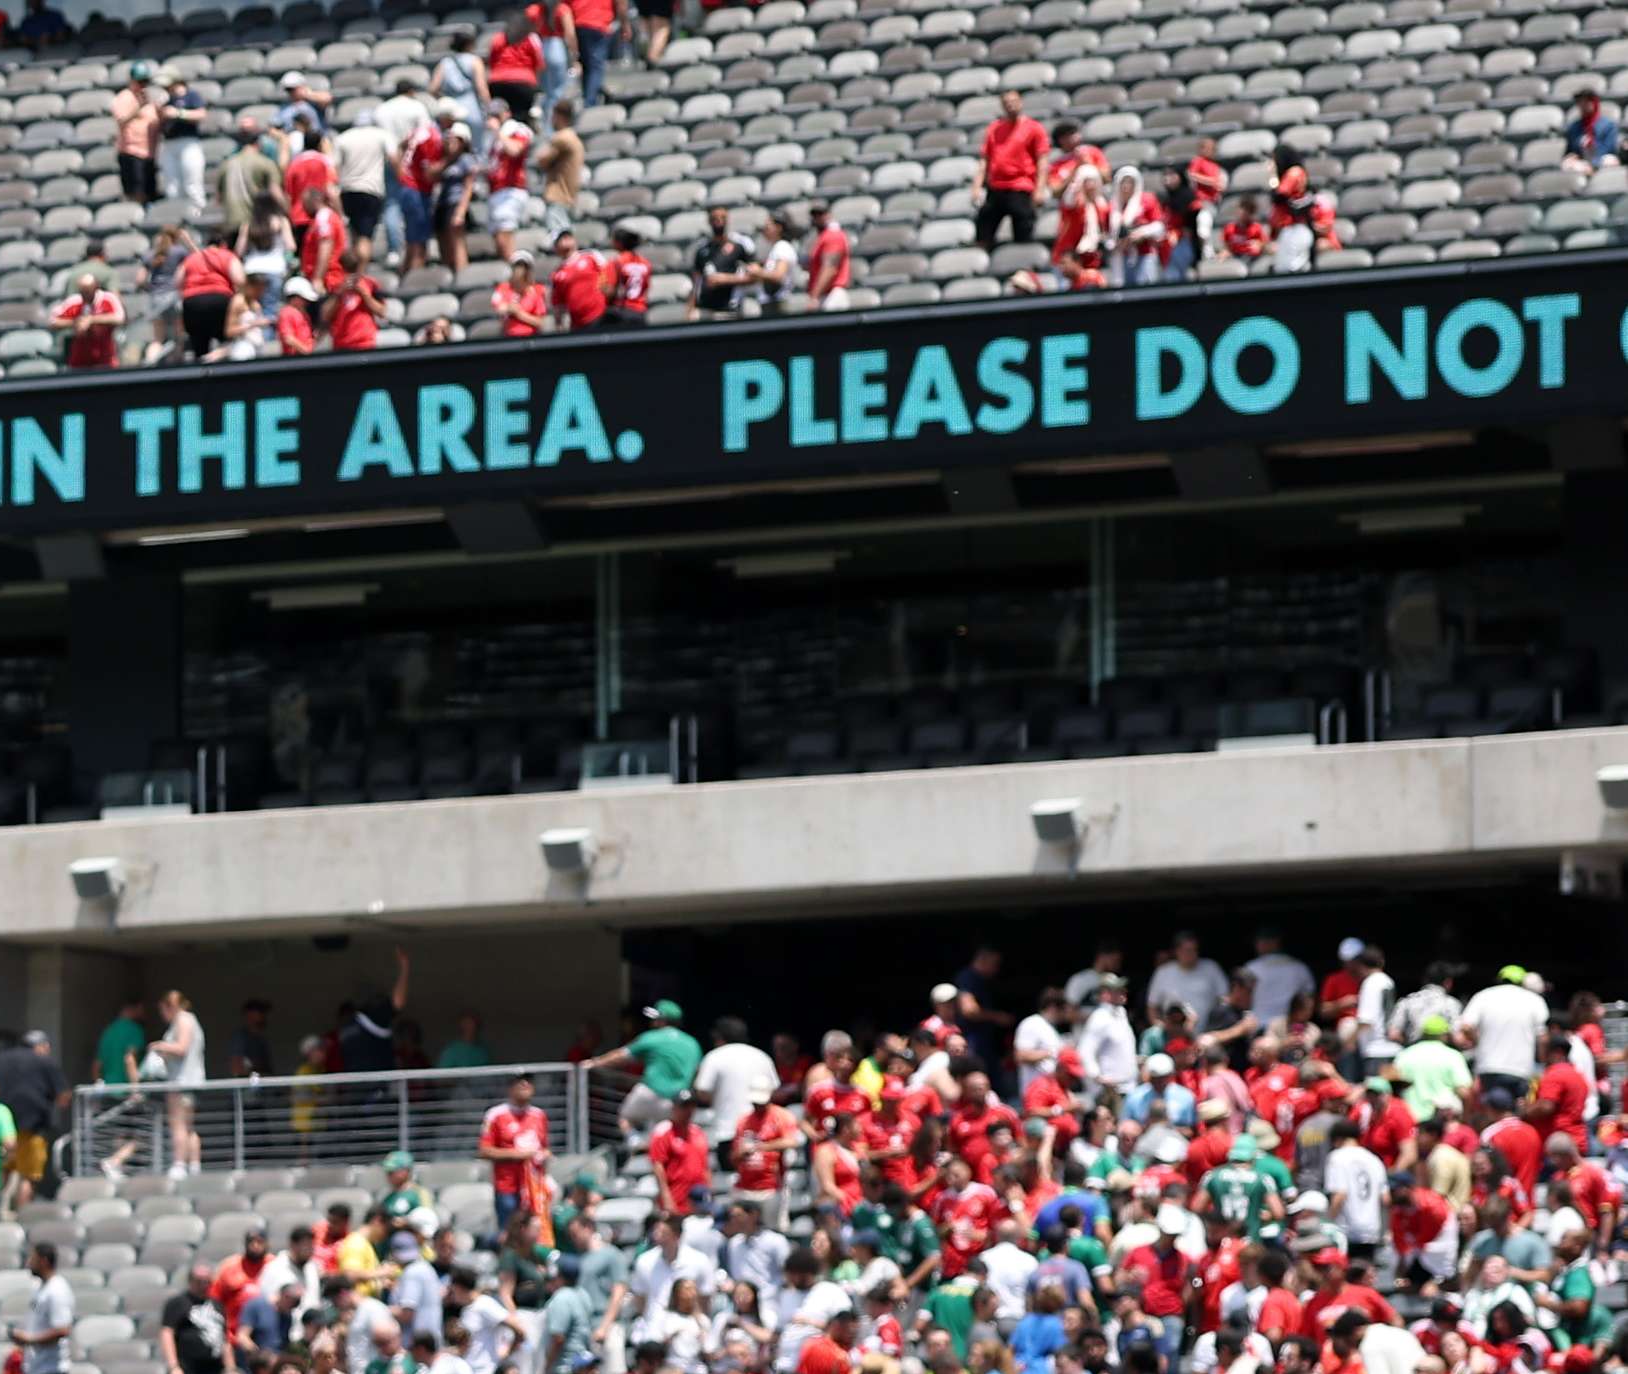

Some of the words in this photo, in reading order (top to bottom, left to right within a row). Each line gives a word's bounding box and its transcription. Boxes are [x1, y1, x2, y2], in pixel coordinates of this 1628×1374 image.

[123, 397, 300, 496] THE
[338, 374, 643, 480] AREA.
[723, 333, 1089, 451] PLEASE
[1135, 316, 1300, 420] DO
[1345, 293, 1580, 404] NOT
